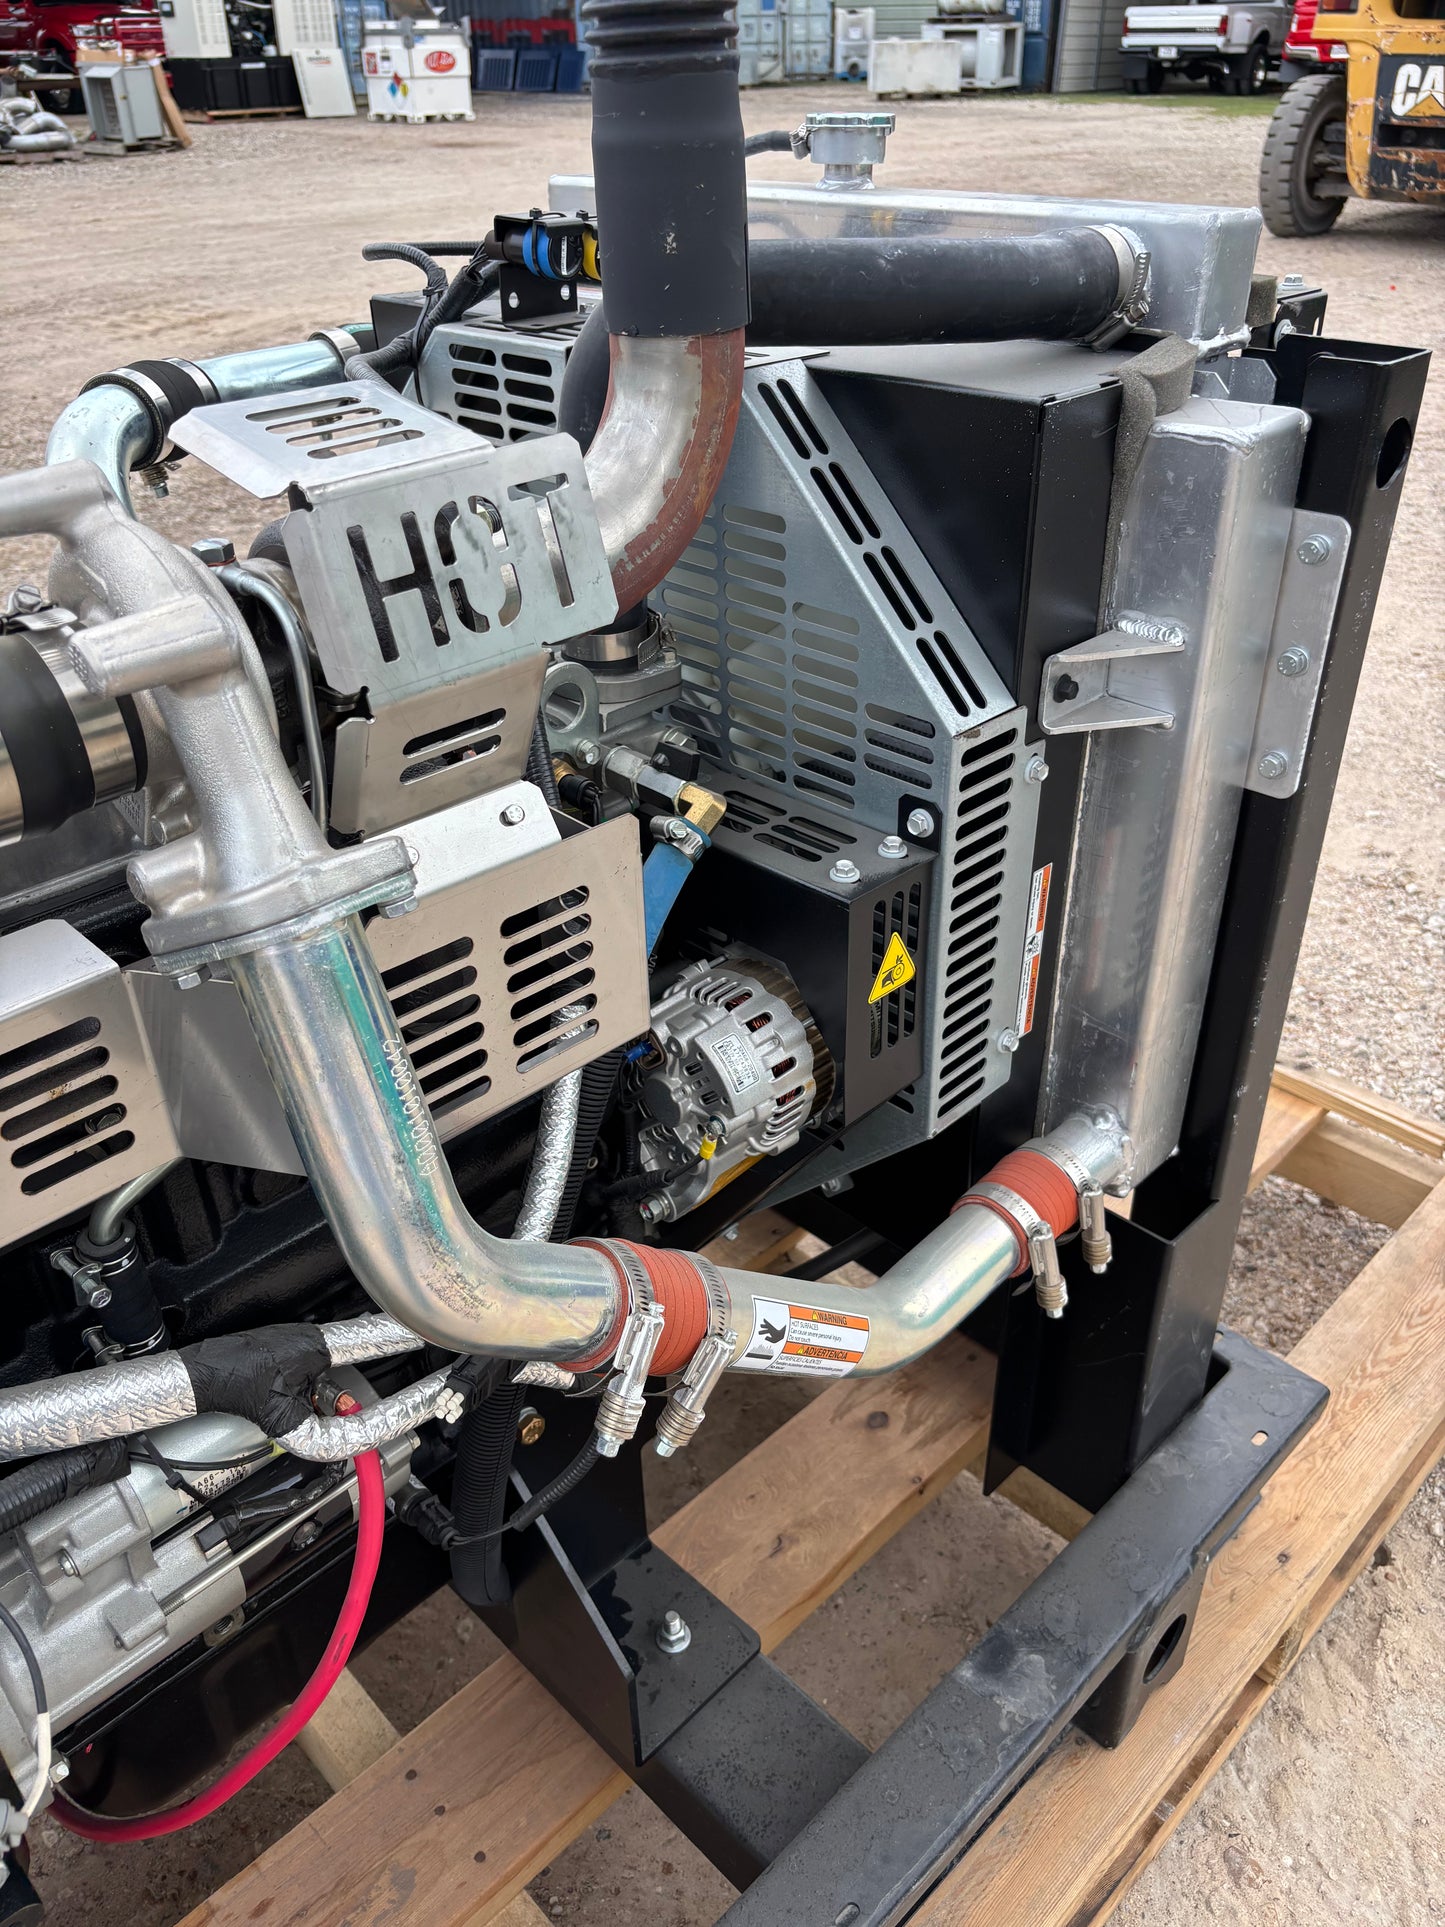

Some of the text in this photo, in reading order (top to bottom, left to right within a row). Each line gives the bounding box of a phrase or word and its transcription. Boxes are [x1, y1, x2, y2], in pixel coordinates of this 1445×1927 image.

[1391, 64, 1445, 116] CA
[346, 472, 575, 663] HOT
[818, 1312, 847, 1325] WARNING
[800, 1322, 818, 1330] SURFACES
[833, 1335, 842, 1343] injury
[804, 1347, 848, 1360] ADVERTENCIA
